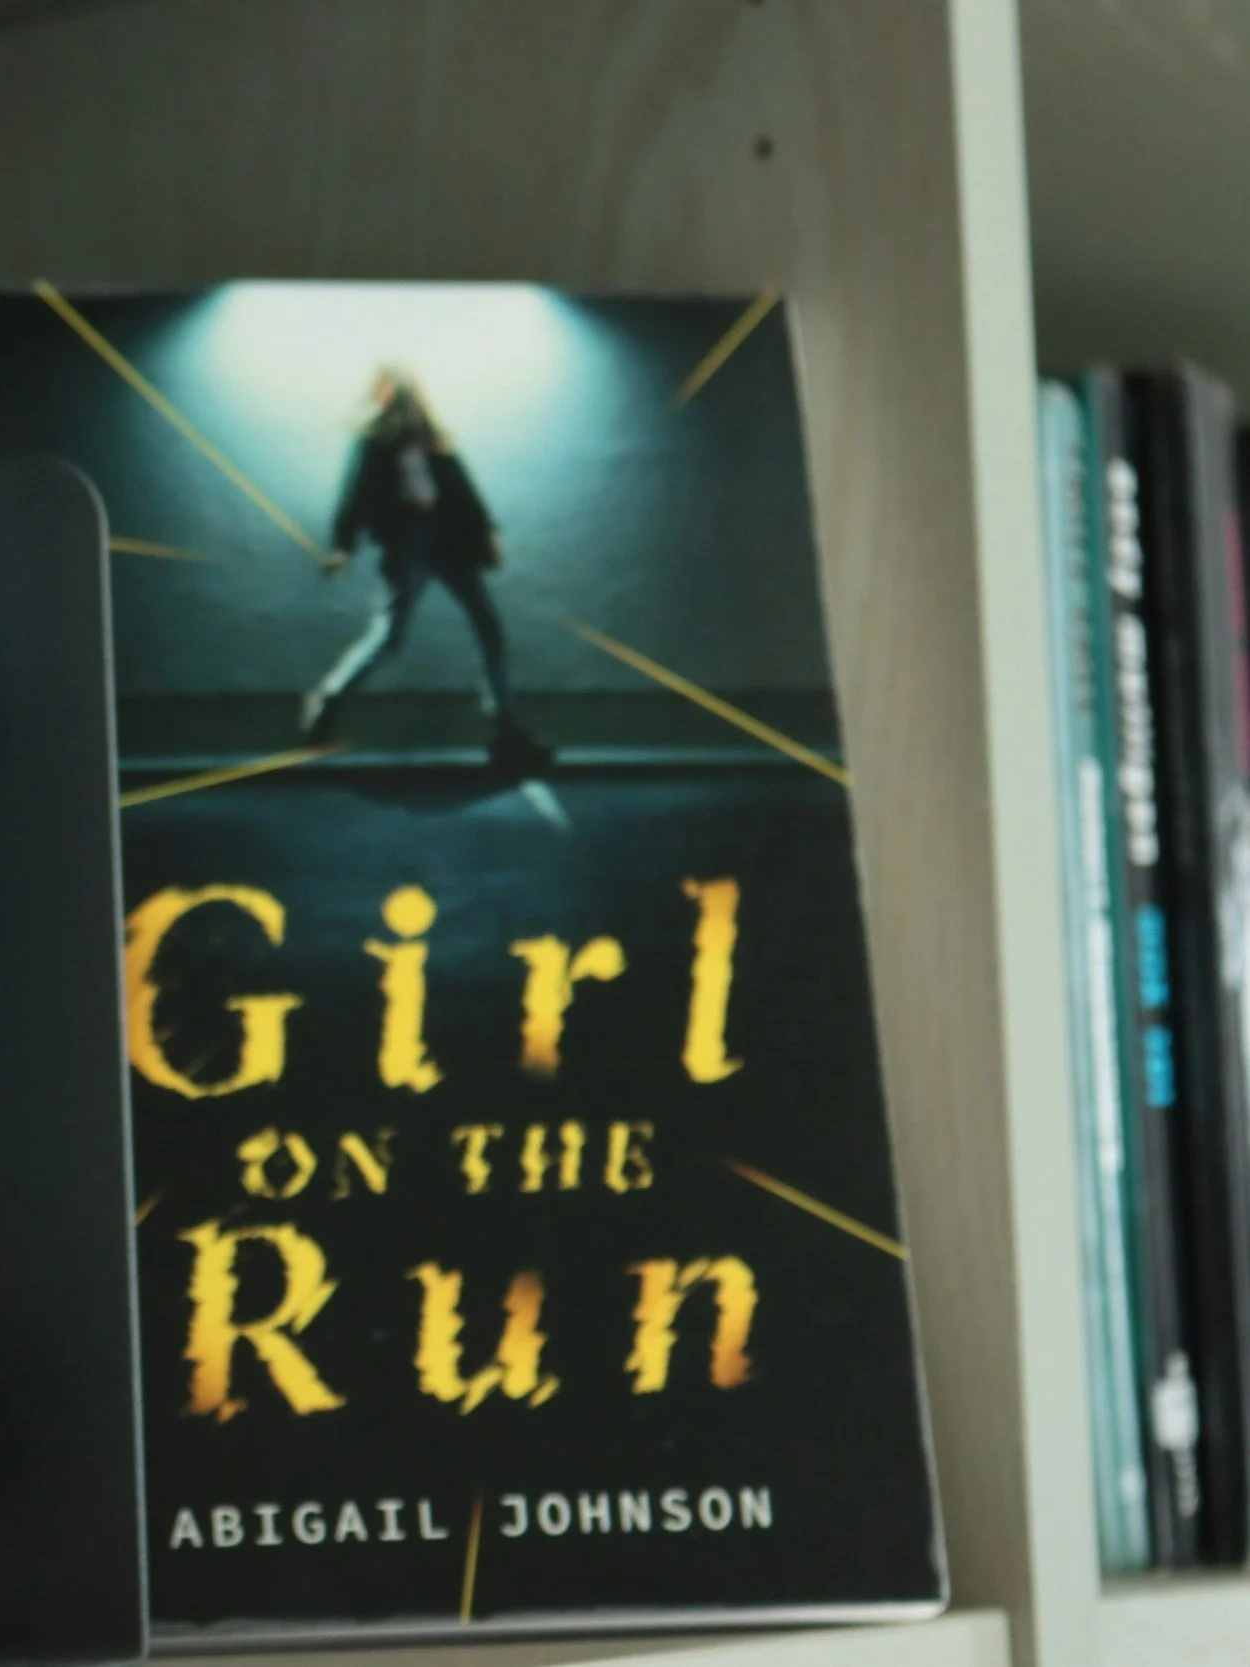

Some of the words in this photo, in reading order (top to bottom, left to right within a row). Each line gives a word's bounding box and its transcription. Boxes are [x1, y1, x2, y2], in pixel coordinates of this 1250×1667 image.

[121, 877, 744, 1099] Girl
[236, 1125, 398, 1202] ON
[452, 1119, 654, 1195] THE
[176, 1219, 759, 1424] Run
[169, 1498, 450, 1549] ABIGAIL
[499, 1487, 774, 1537] JOHNSON
